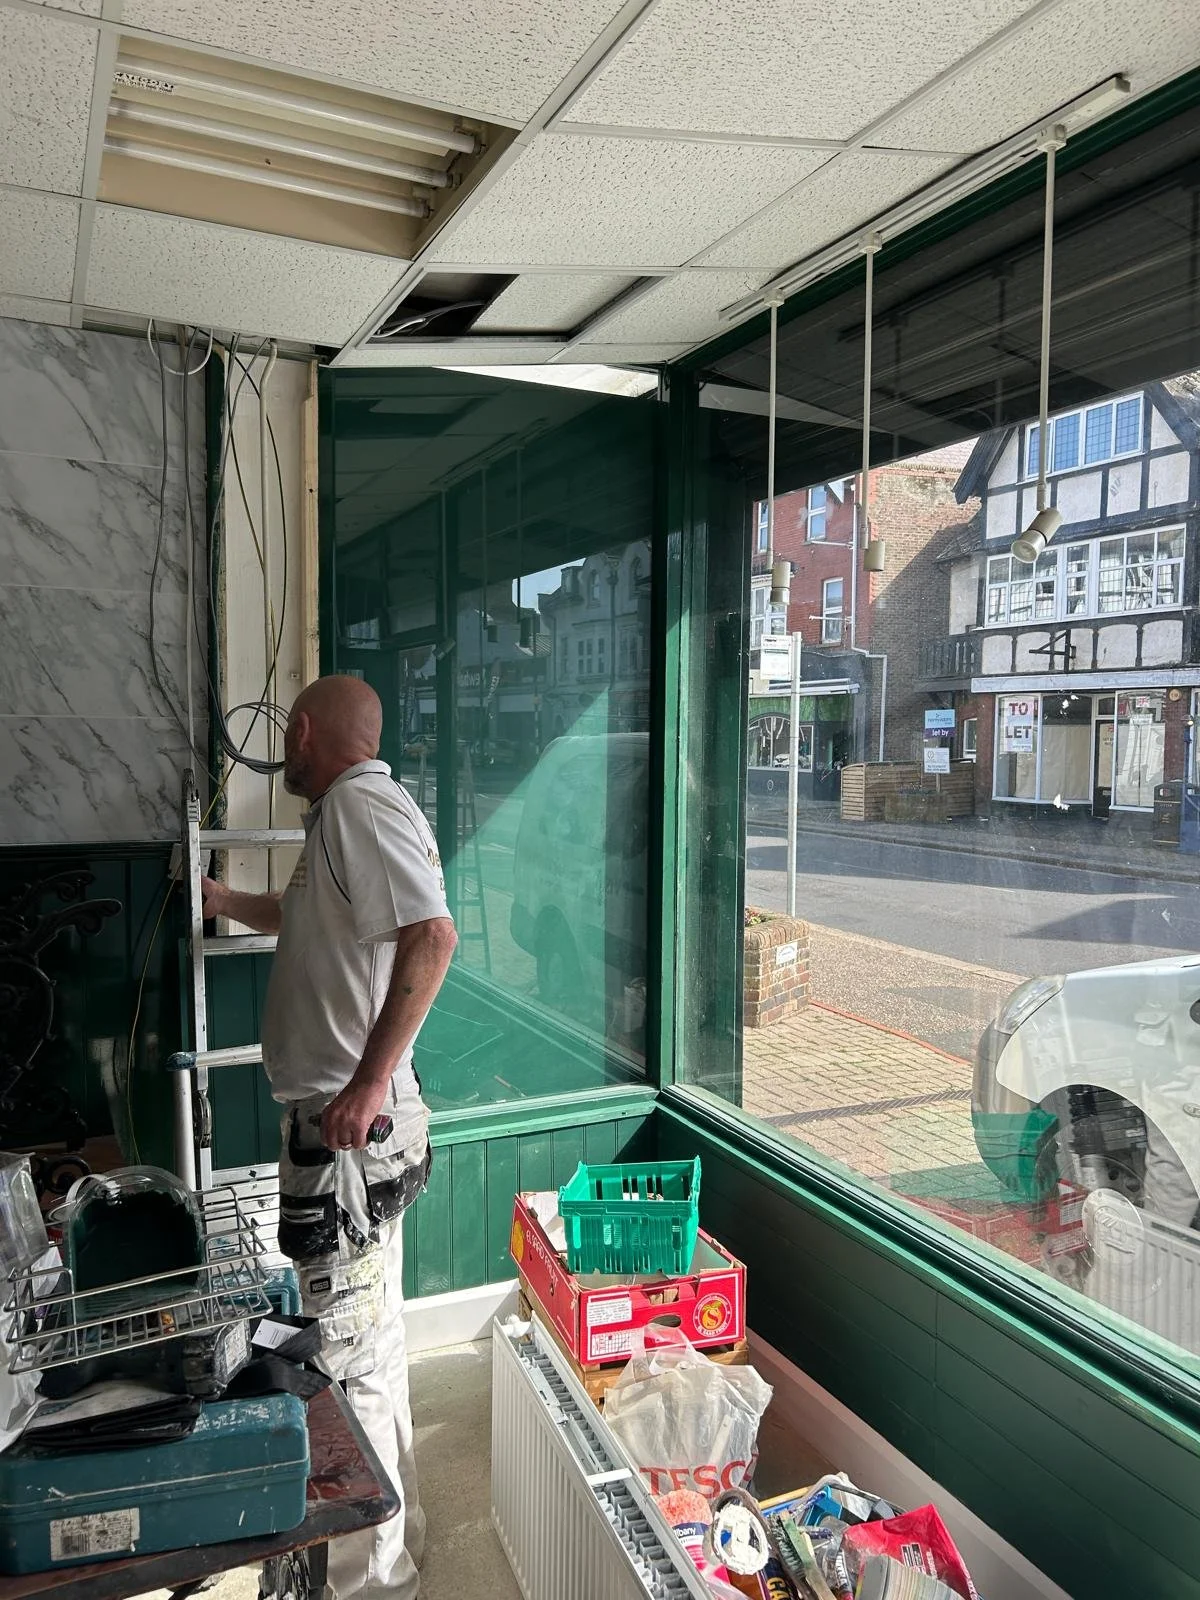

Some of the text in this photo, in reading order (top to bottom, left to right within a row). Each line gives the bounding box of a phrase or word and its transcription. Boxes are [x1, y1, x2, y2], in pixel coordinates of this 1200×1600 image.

[1009, 703, 1028, 715] TO
[941, 729, 949, 737] by
[1005, 725, 1032, 738] LET
